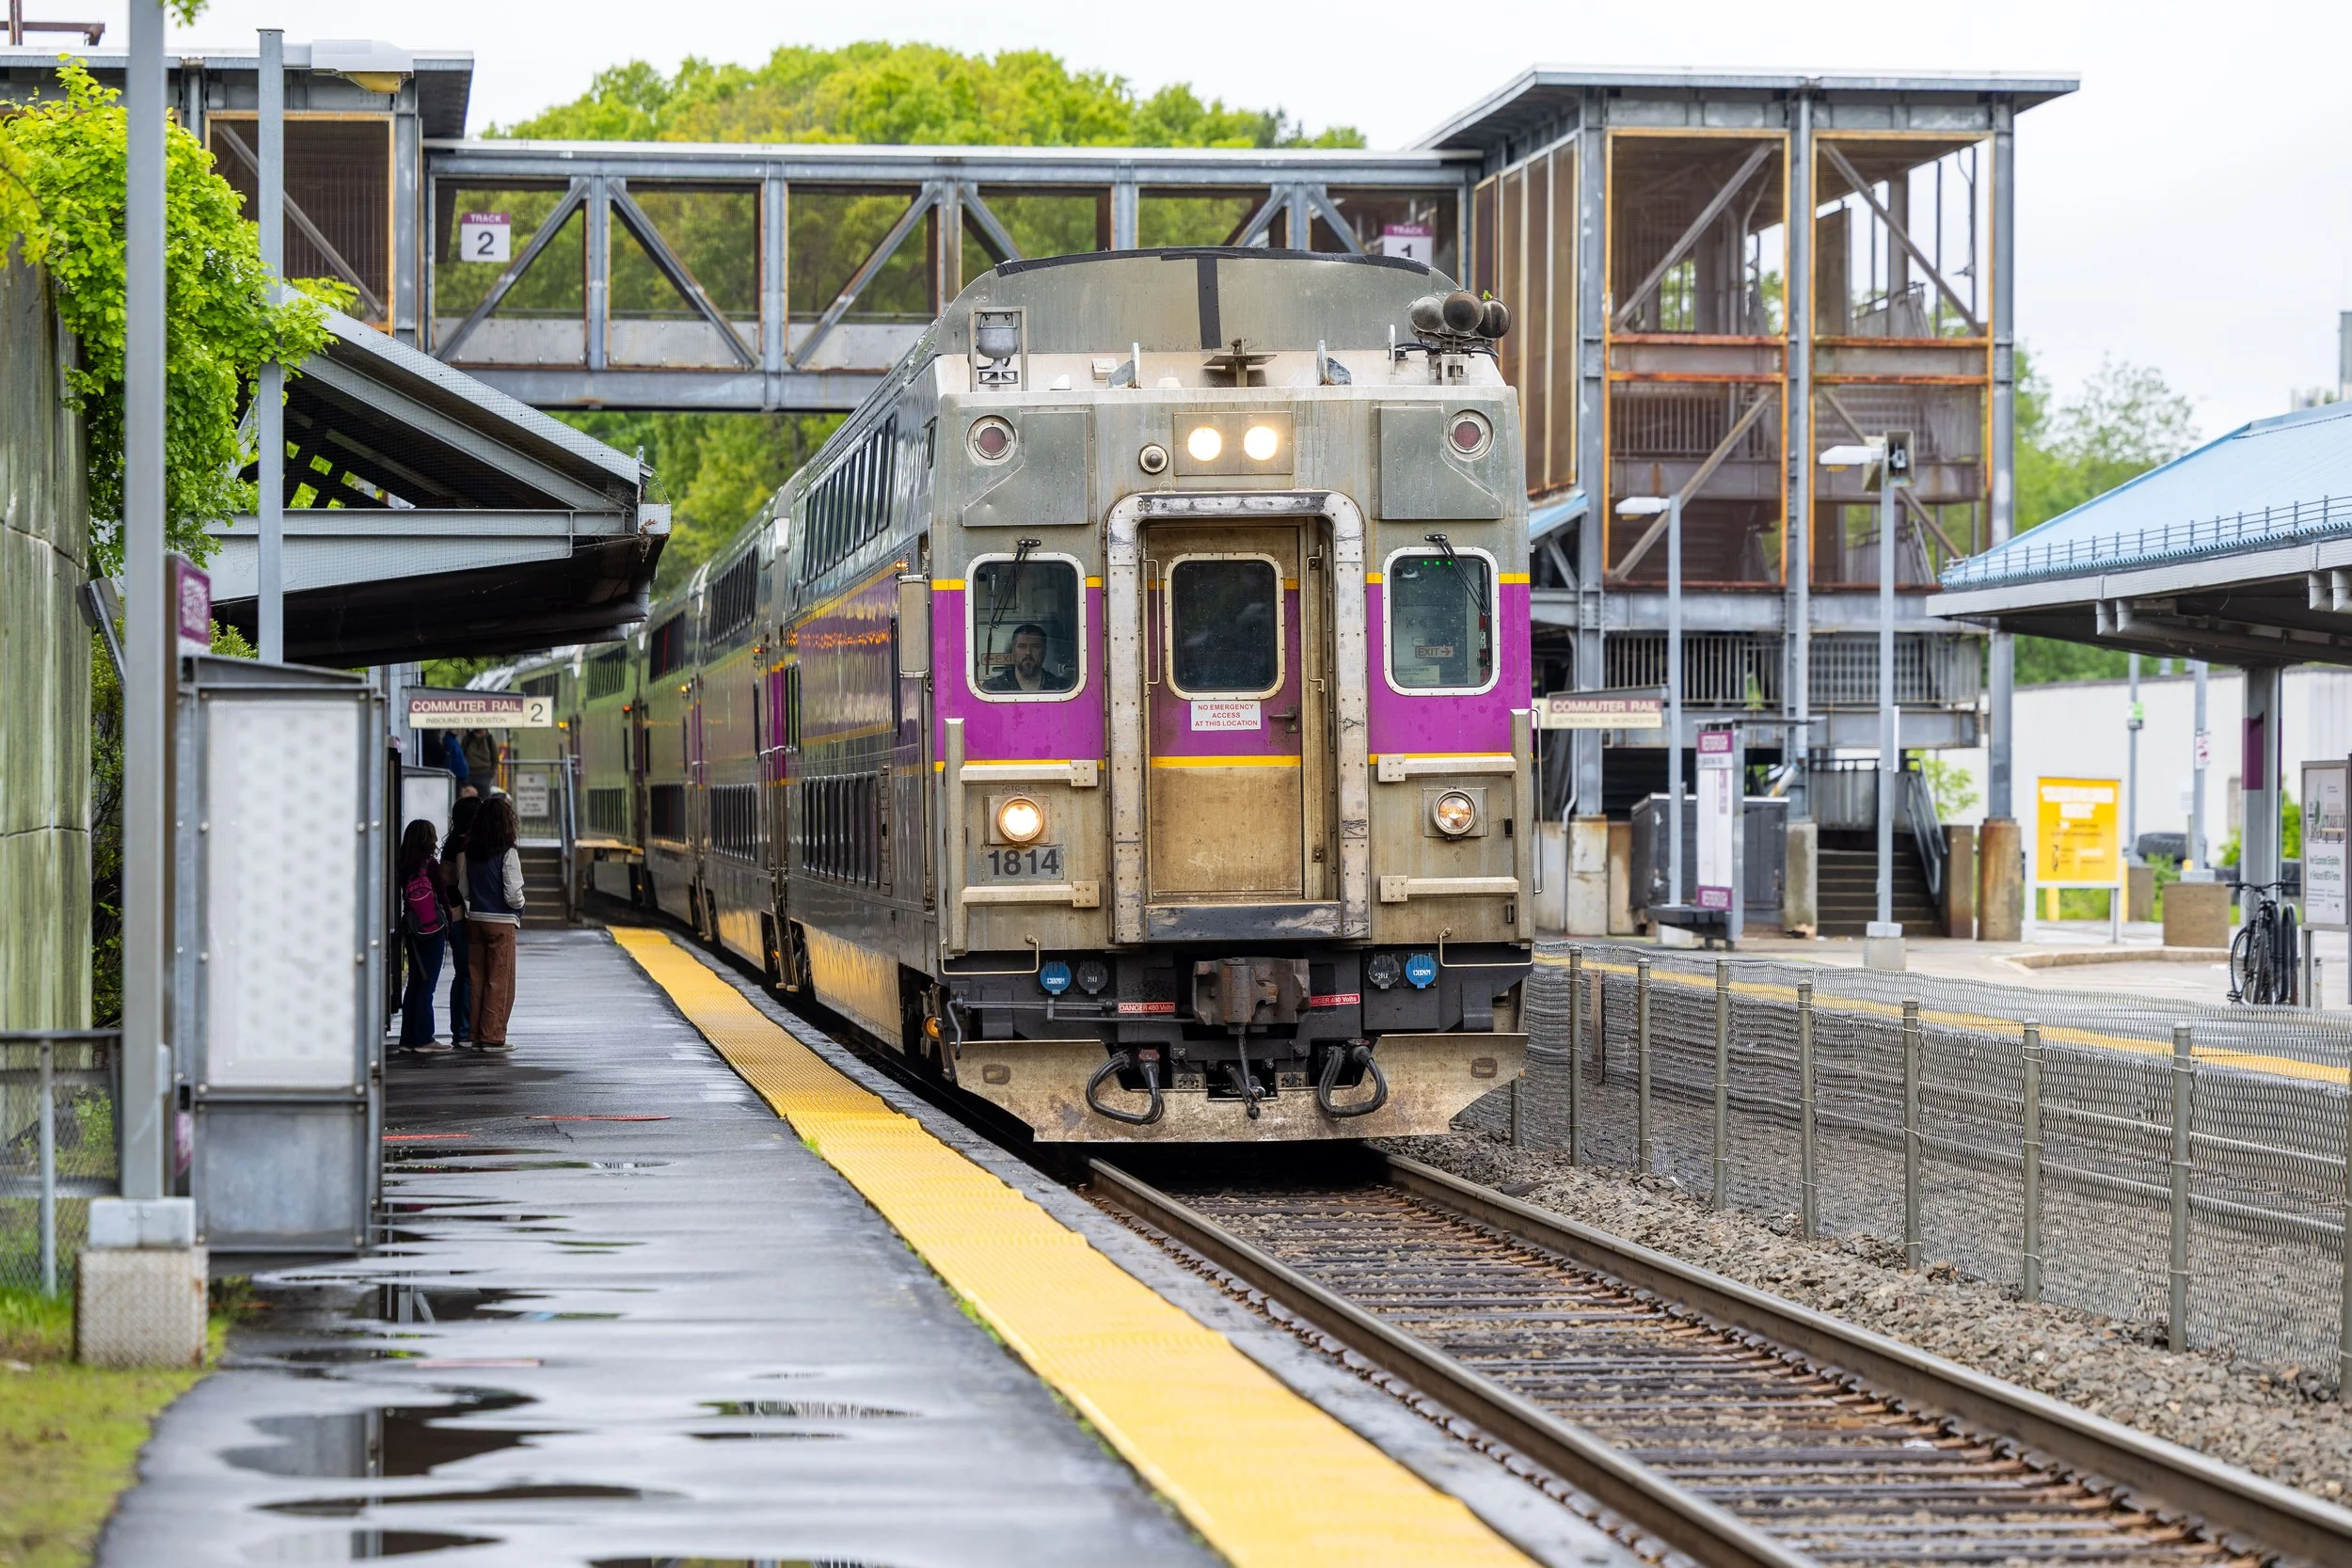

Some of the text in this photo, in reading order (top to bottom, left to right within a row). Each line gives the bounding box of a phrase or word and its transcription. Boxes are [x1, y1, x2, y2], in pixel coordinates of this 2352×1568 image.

[470, 214, 501, 223] TRACK
[1392, 226, 1423, 234] TRACK
[477, 231, 494, 255] 2
[412, 700, 520, 712] COMMUTER RAIL
[1552, 700, 1659, 712] COMMUTER RAIL
[531, 703, 543, 722] 2
[988, 848, 1059, 876] 1814
